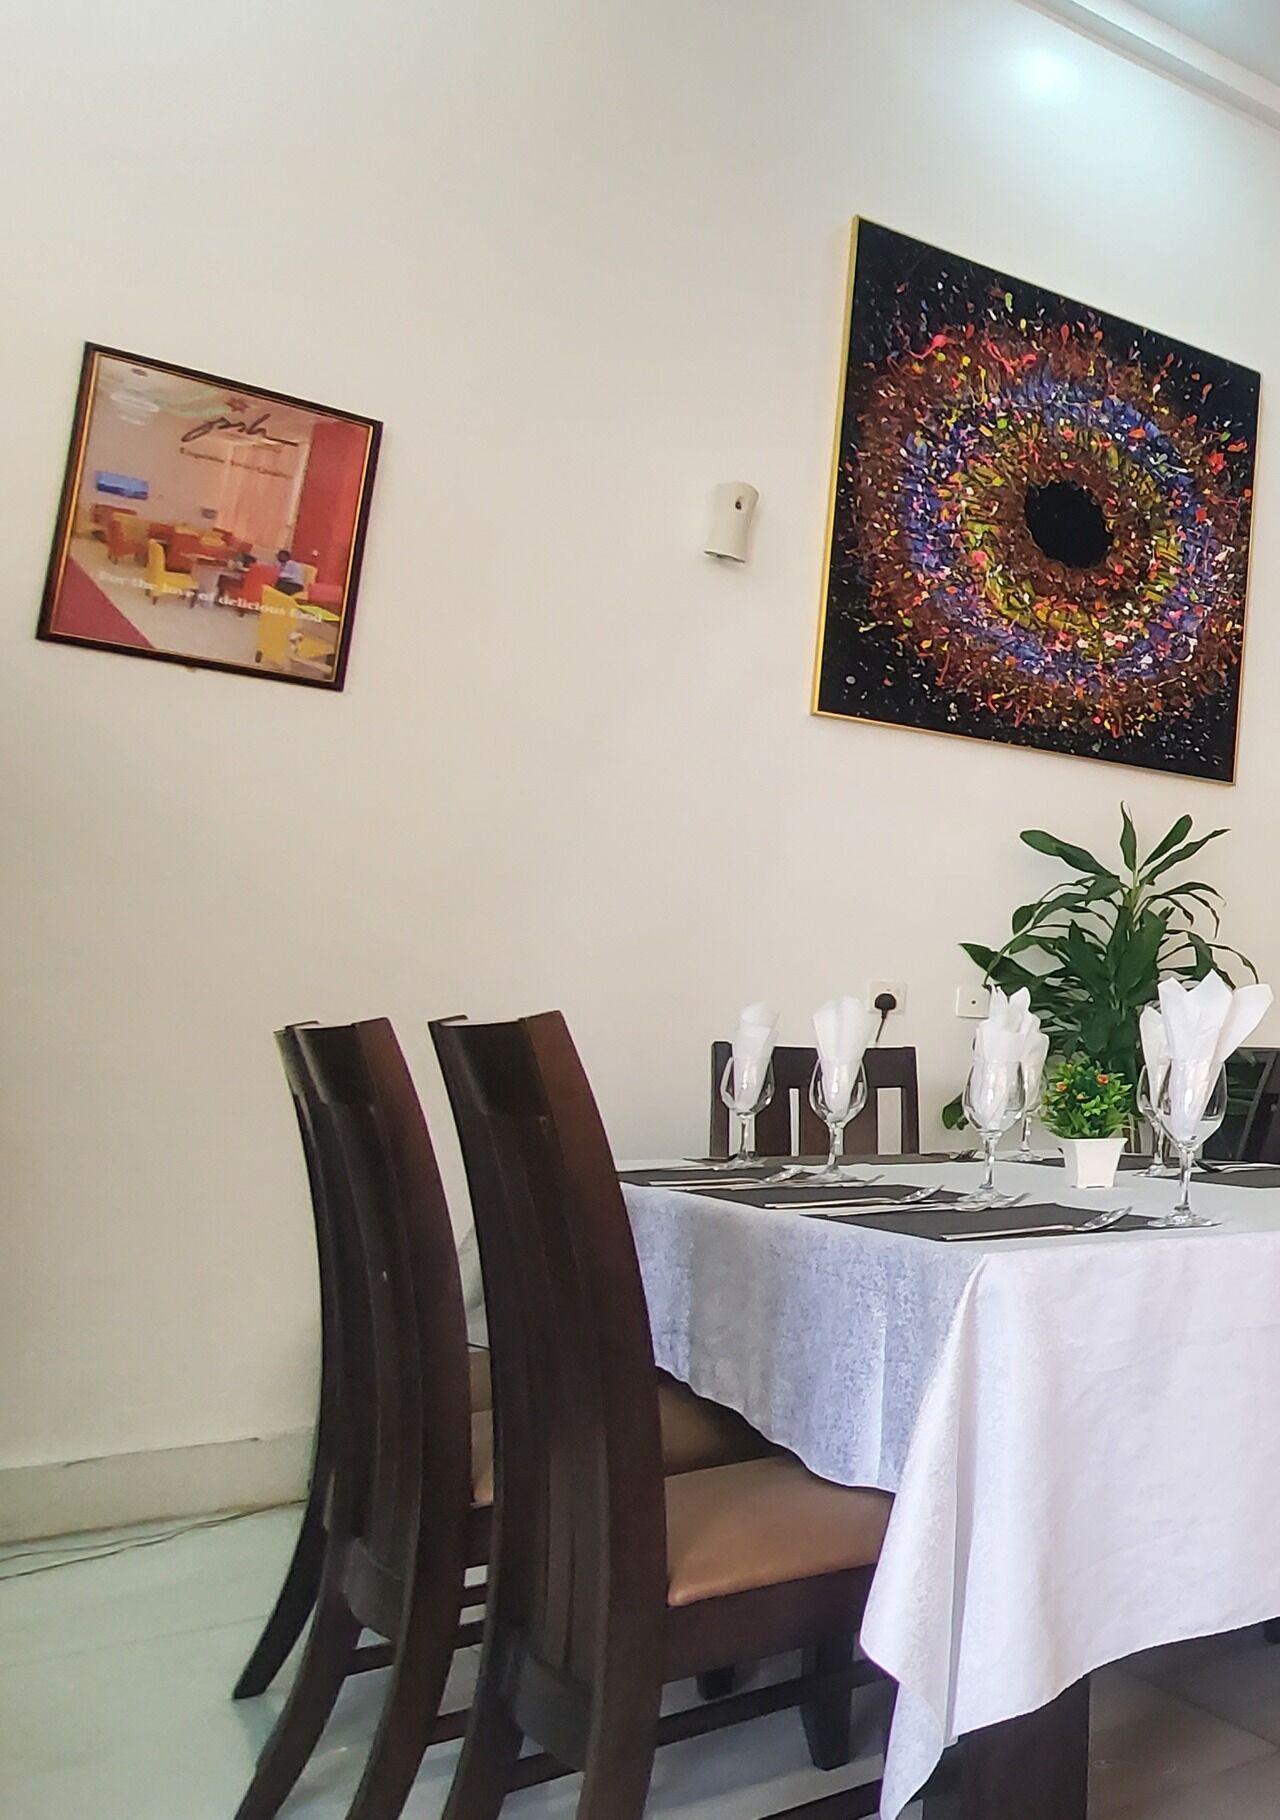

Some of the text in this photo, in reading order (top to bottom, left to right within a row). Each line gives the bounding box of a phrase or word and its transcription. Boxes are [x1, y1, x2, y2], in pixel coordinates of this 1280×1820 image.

[131, 576, 158, 591] the
[162, 582, 196, 599] love
[198, 590, 216, 603] of
[218, 591, 286, 616] delicious
[289, 607, 322, 624] food
